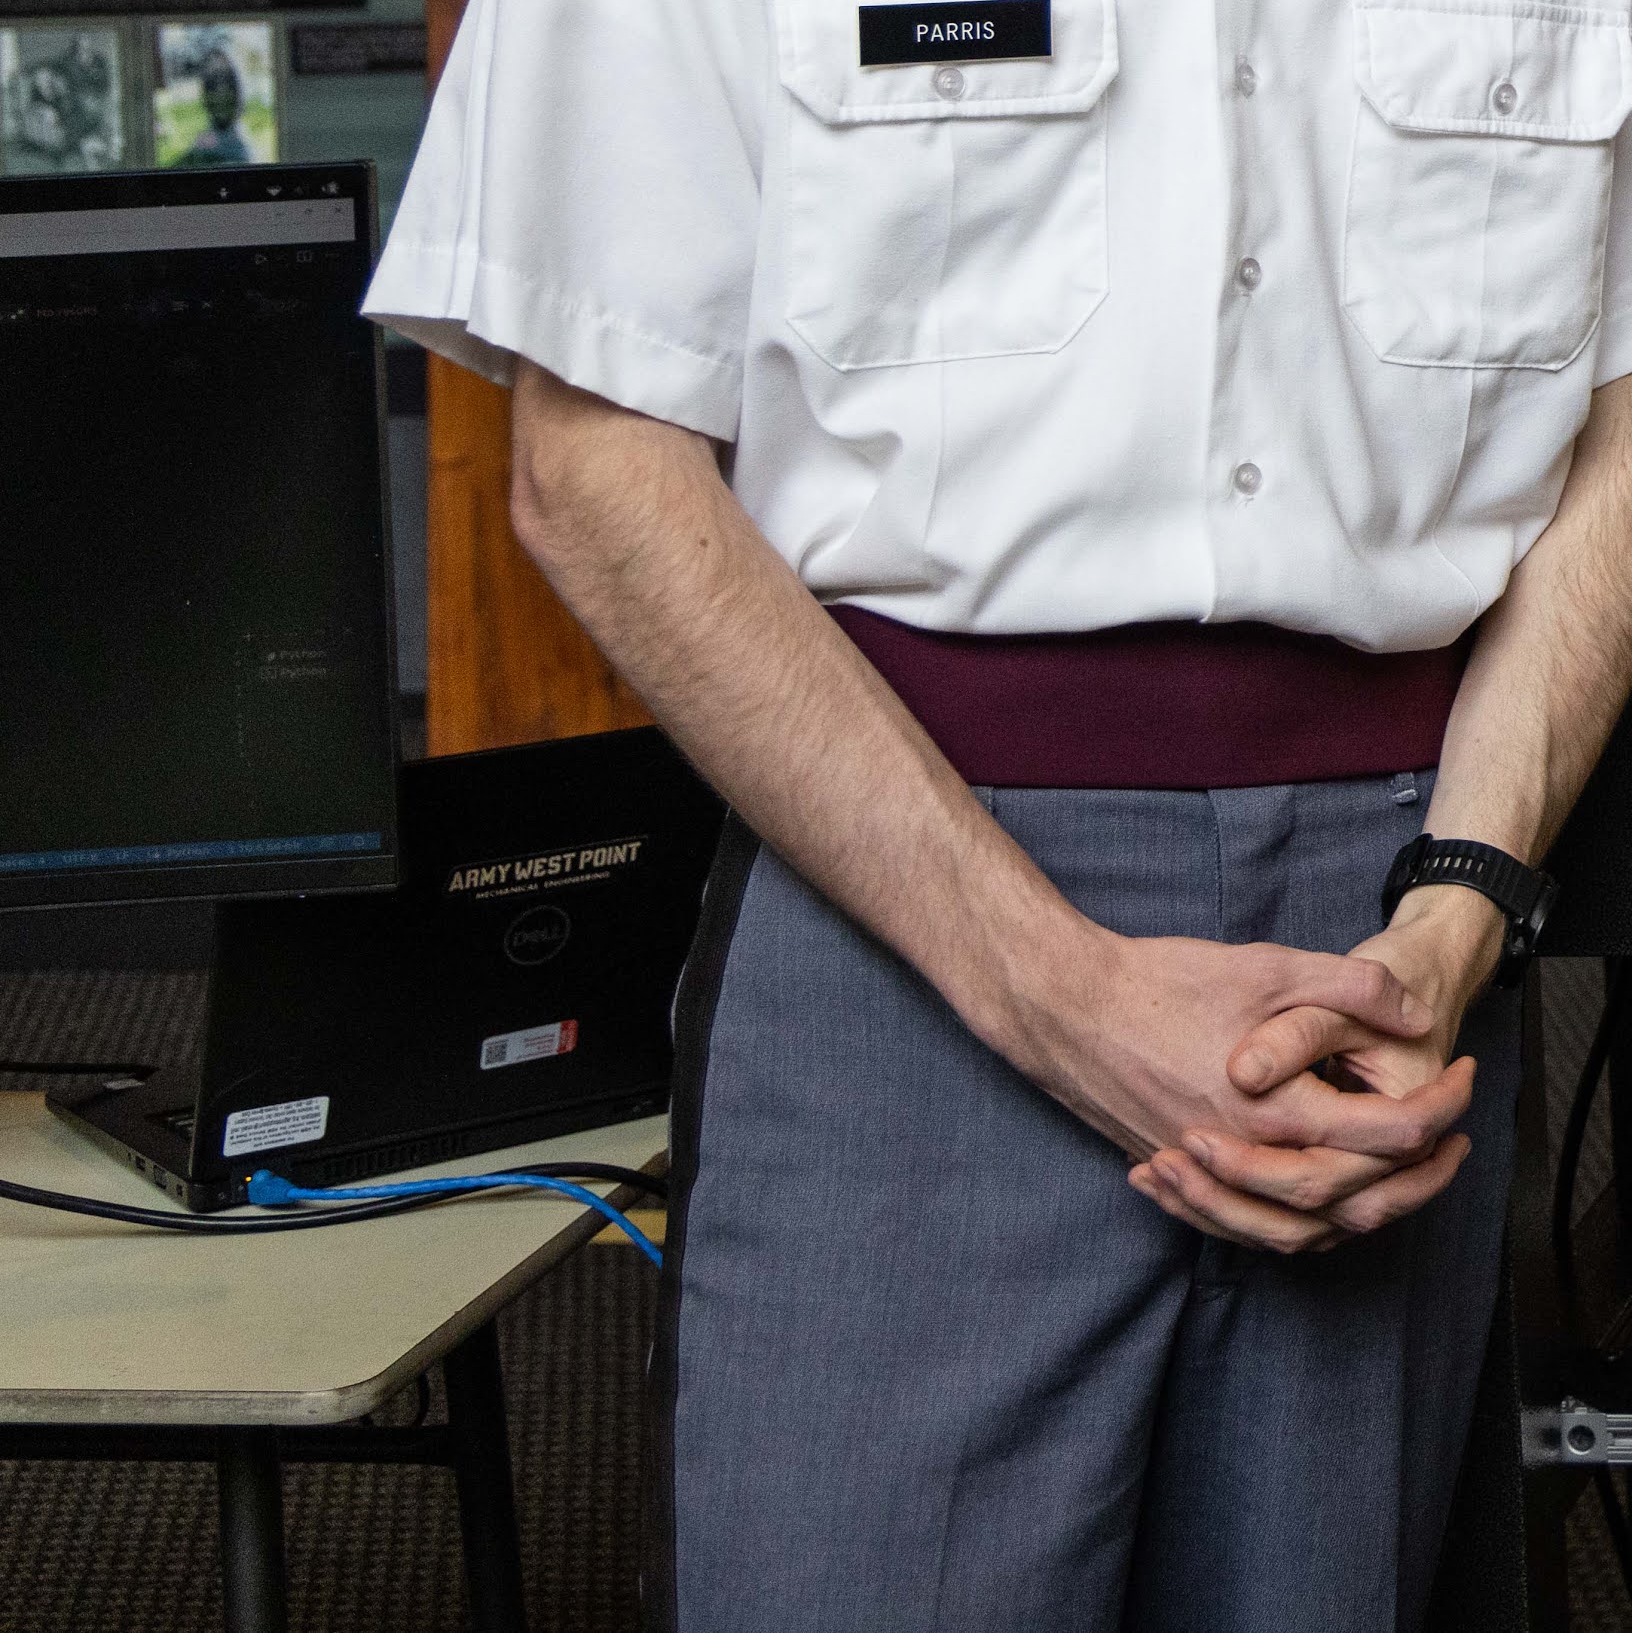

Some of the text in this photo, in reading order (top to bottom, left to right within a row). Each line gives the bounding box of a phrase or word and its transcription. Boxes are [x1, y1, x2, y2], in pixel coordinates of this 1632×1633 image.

[916, 21, 995, 43] PARRIS
[448, 841, 642, 892] ARMY WEST POINT
[475, 883, 538, 900] MECHANICAL
